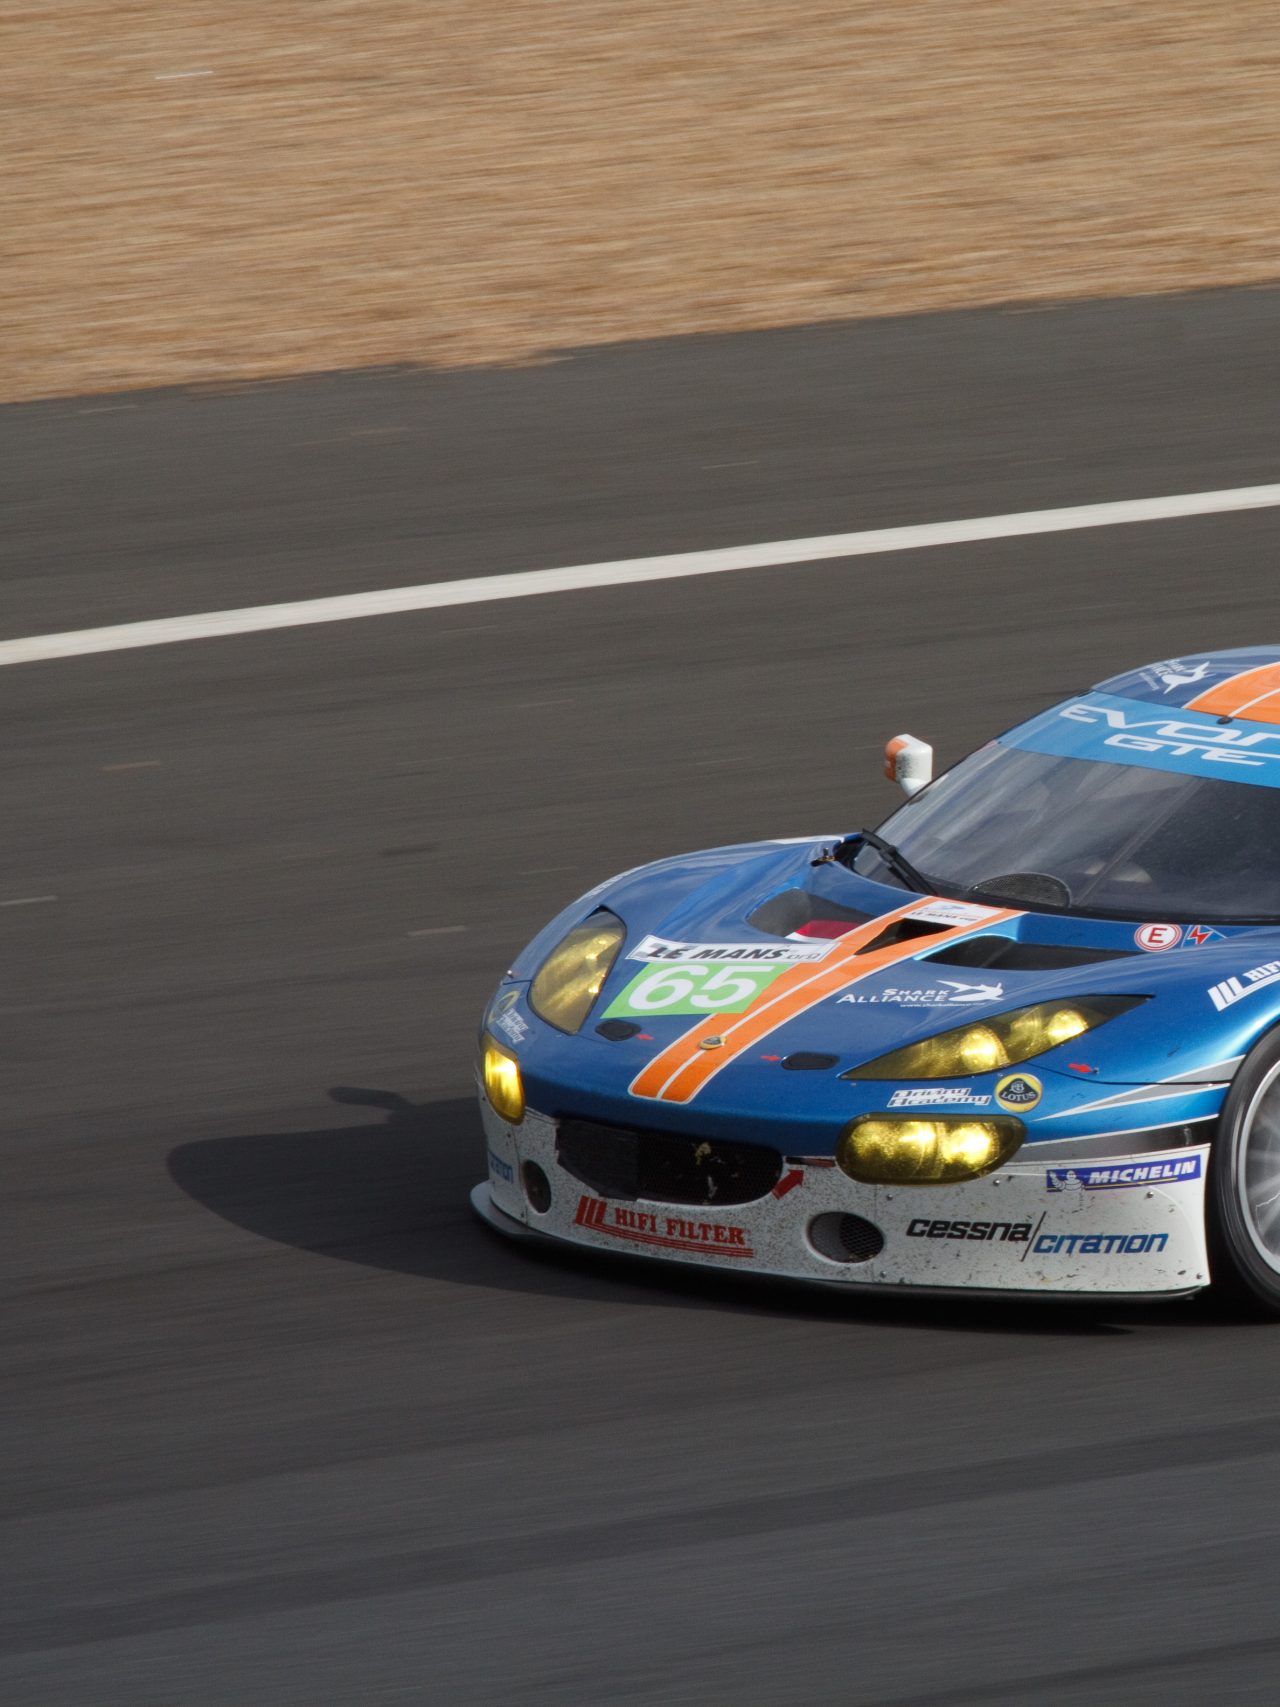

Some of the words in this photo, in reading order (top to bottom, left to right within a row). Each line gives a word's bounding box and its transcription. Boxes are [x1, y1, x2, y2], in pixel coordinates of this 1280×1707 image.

[647, 947, 687, 959] LE
[689, 949, 788, 960] MANS
[628, 965, 775, 1010] 65
[836, 993, 945, 1004] ALLIANCE
[1001, 1091, 1037, 1101] LOTUS
[1088, 1160, 1197, 1184] MICHELIN
[615, 1208, 657, 1232] HIFI
[665, 1218, 745, 1245] FILTER
